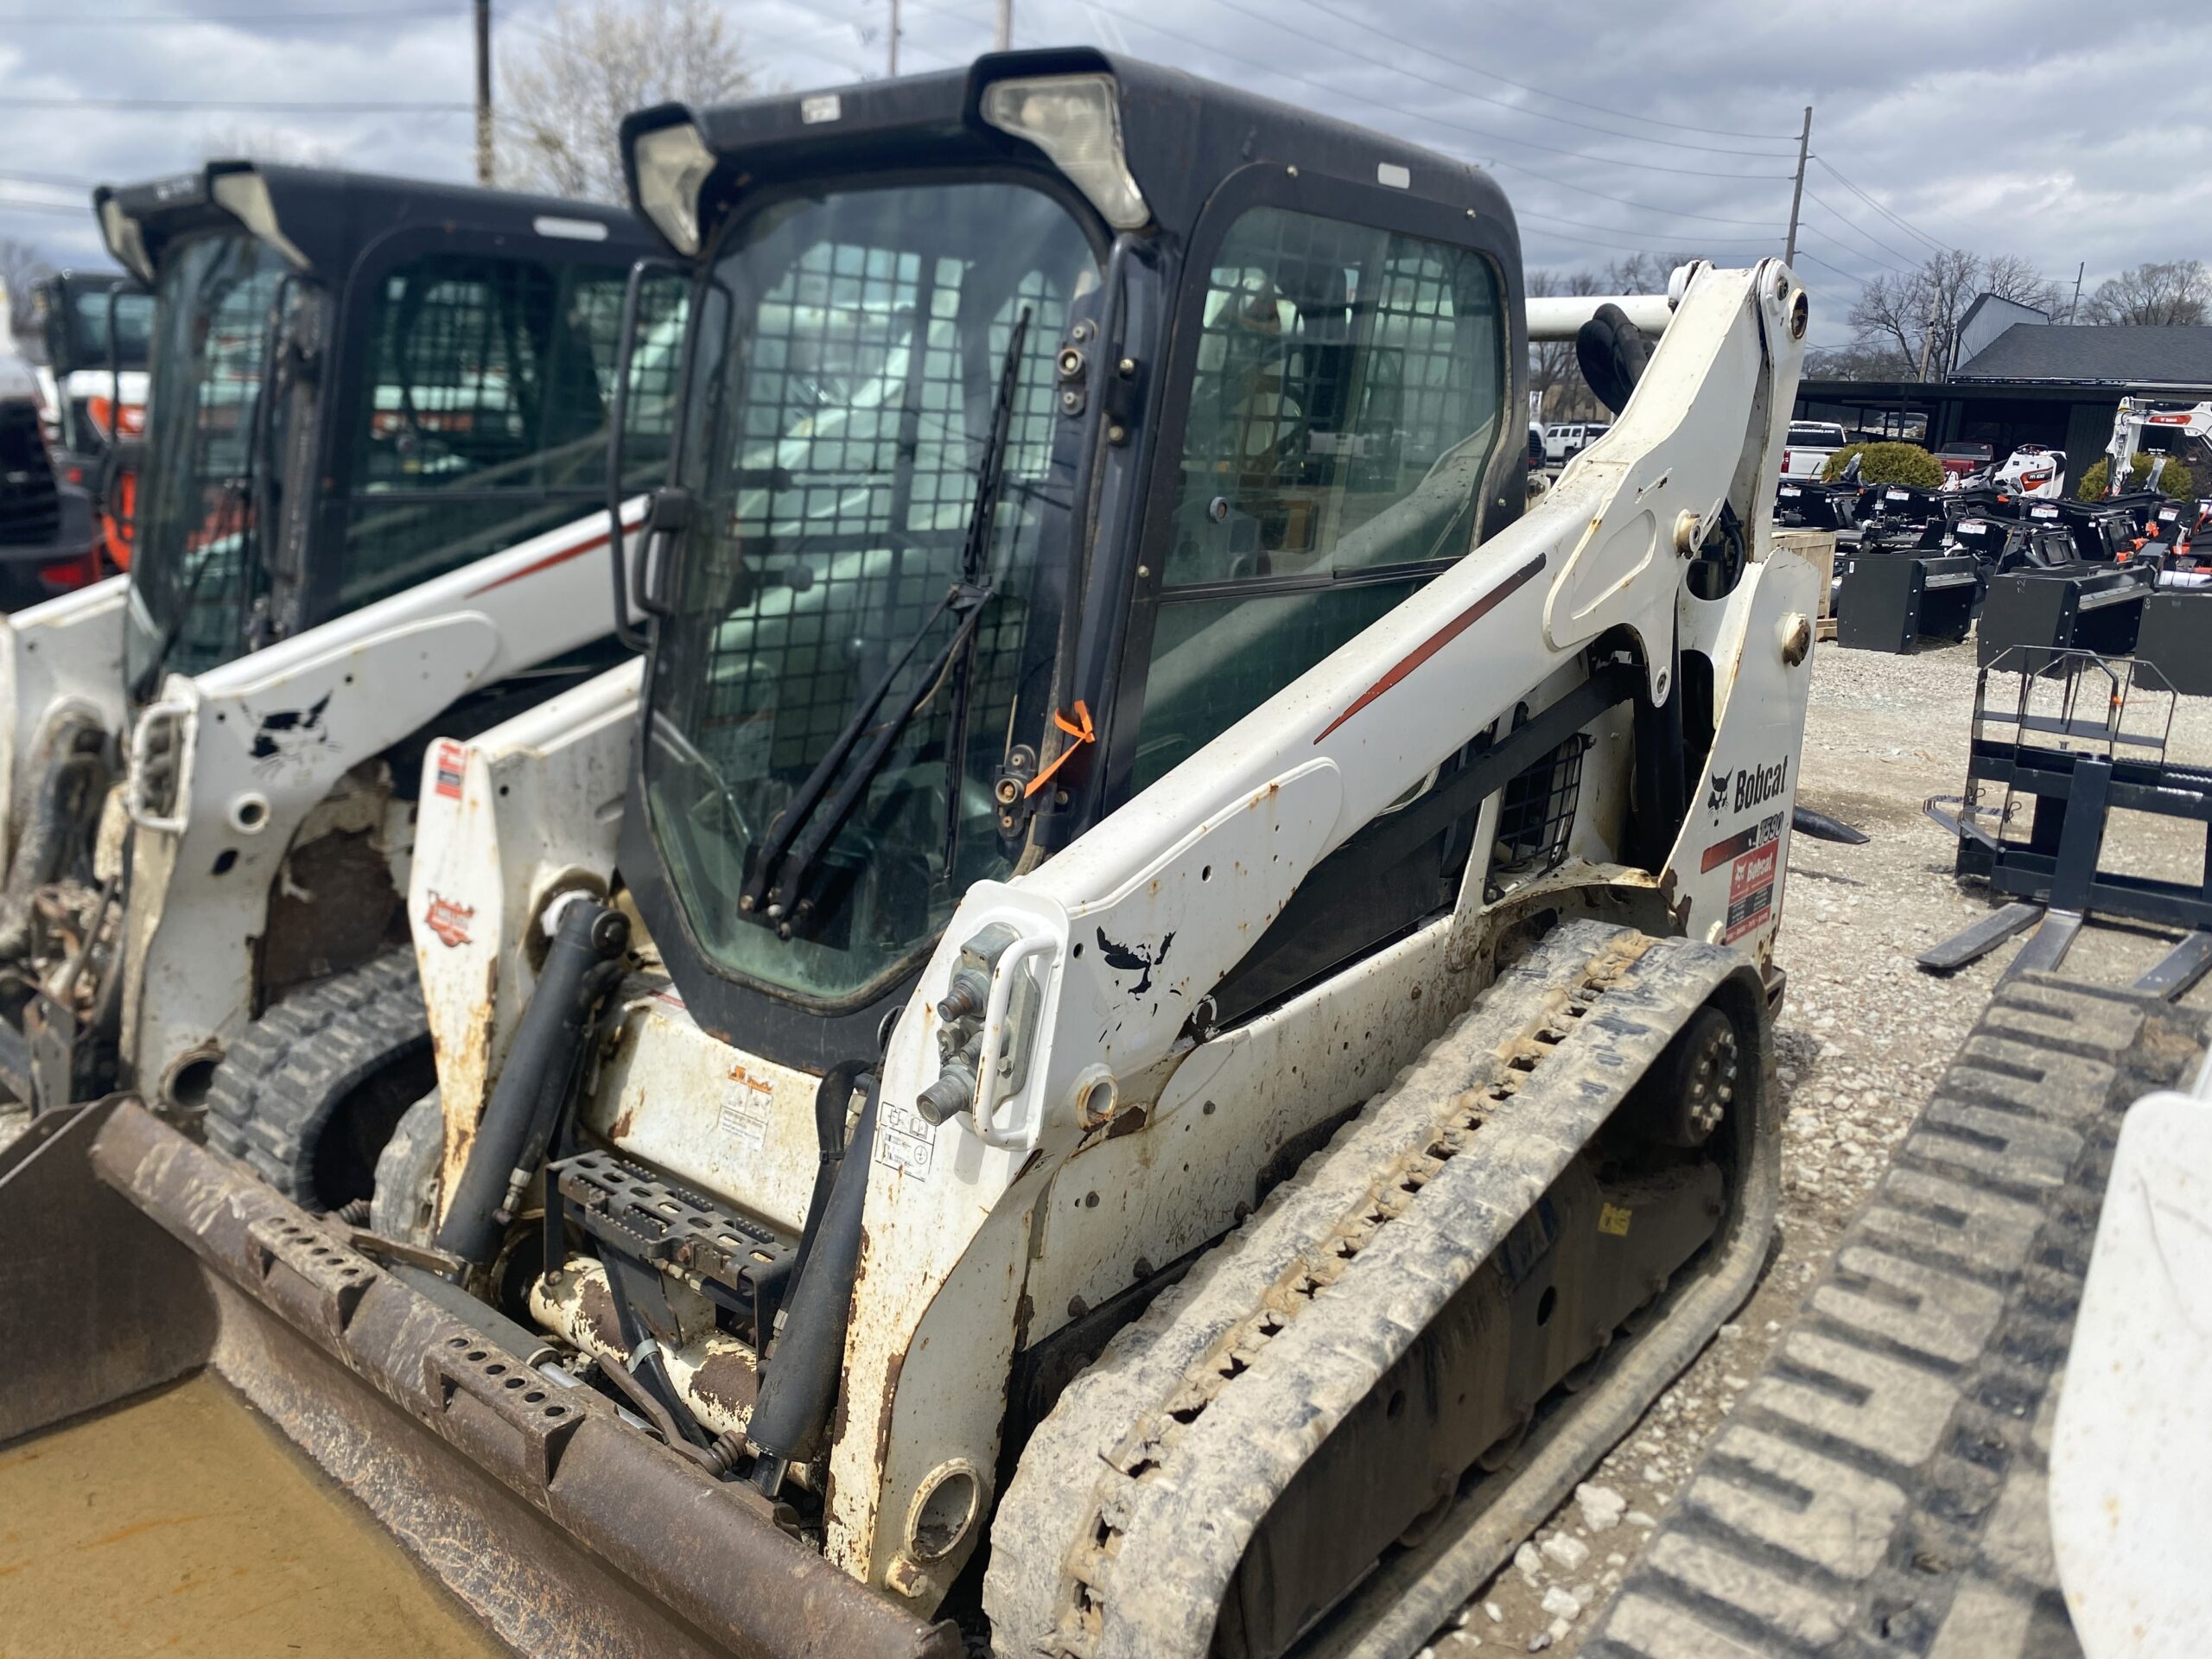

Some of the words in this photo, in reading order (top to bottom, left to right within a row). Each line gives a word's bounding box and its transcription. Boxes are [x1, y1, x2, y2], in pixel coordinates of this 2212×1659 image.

[1733, 754, 1788, 814] Bobcat
[1758, 810, 1784, 847] T590
[1747, 852, 1772, 881] Bobcat
